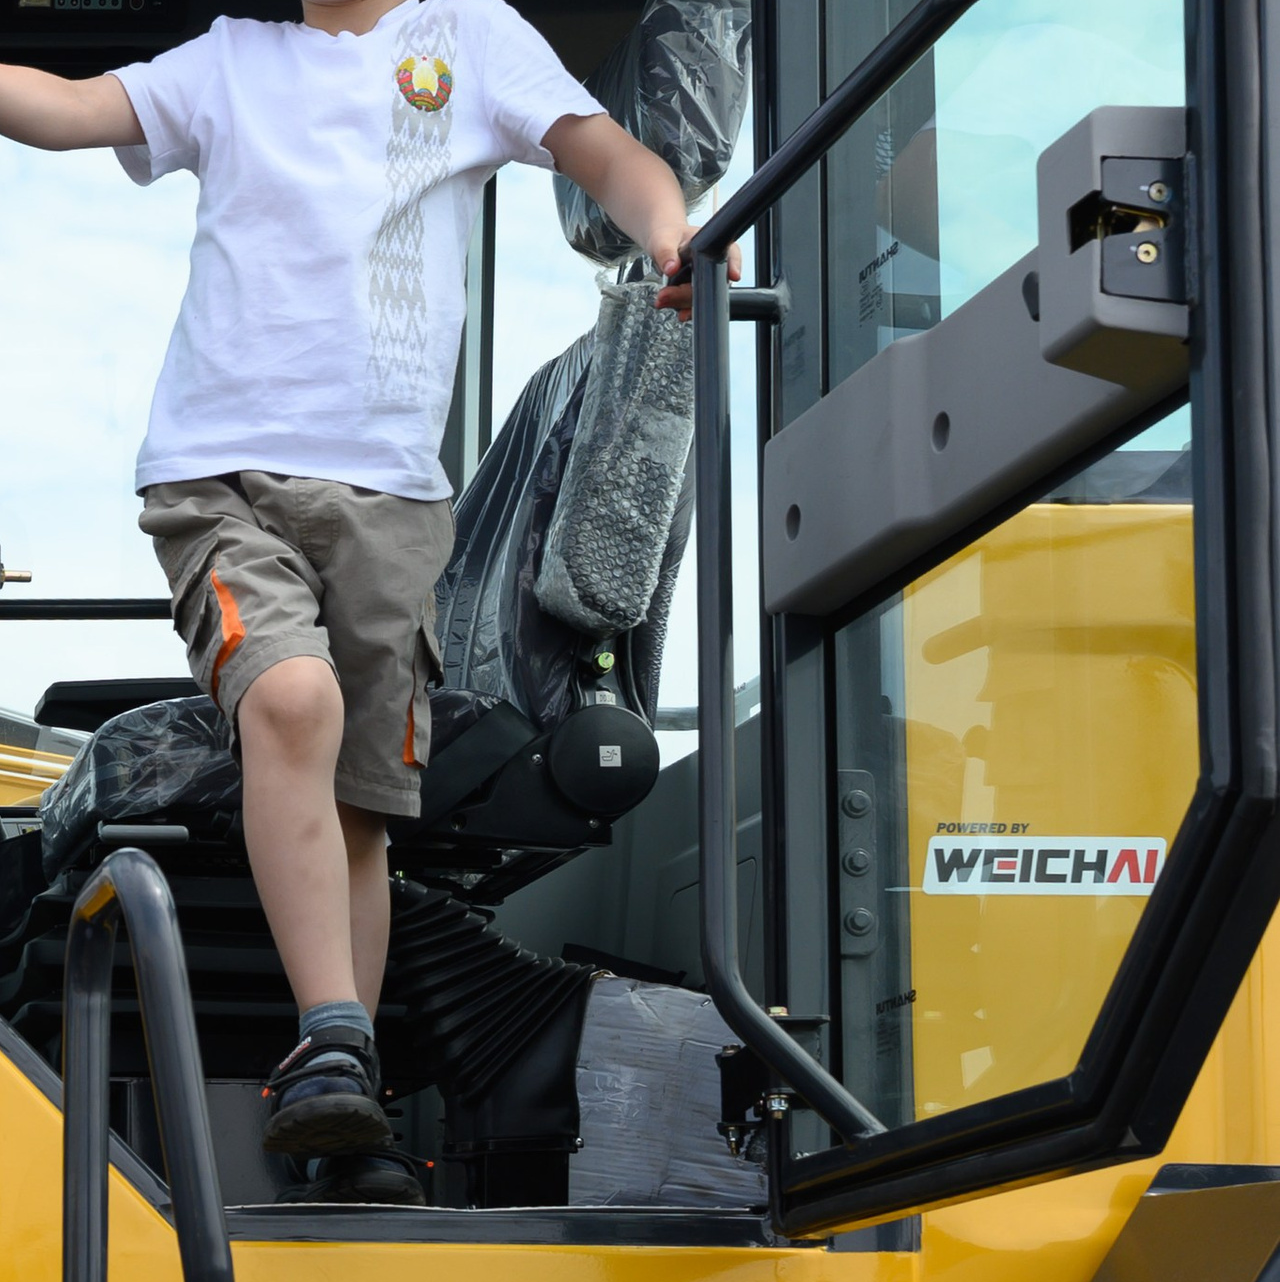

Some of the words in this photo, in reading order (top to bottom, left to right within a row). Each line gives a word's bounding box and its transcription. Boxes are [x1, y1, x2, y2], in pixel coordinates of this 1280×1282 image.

[936, 822, 1008, 834] POWERED
[1010, 822, 1030, 834] BY
[933, 848, 1159, 884] WEICHAI
